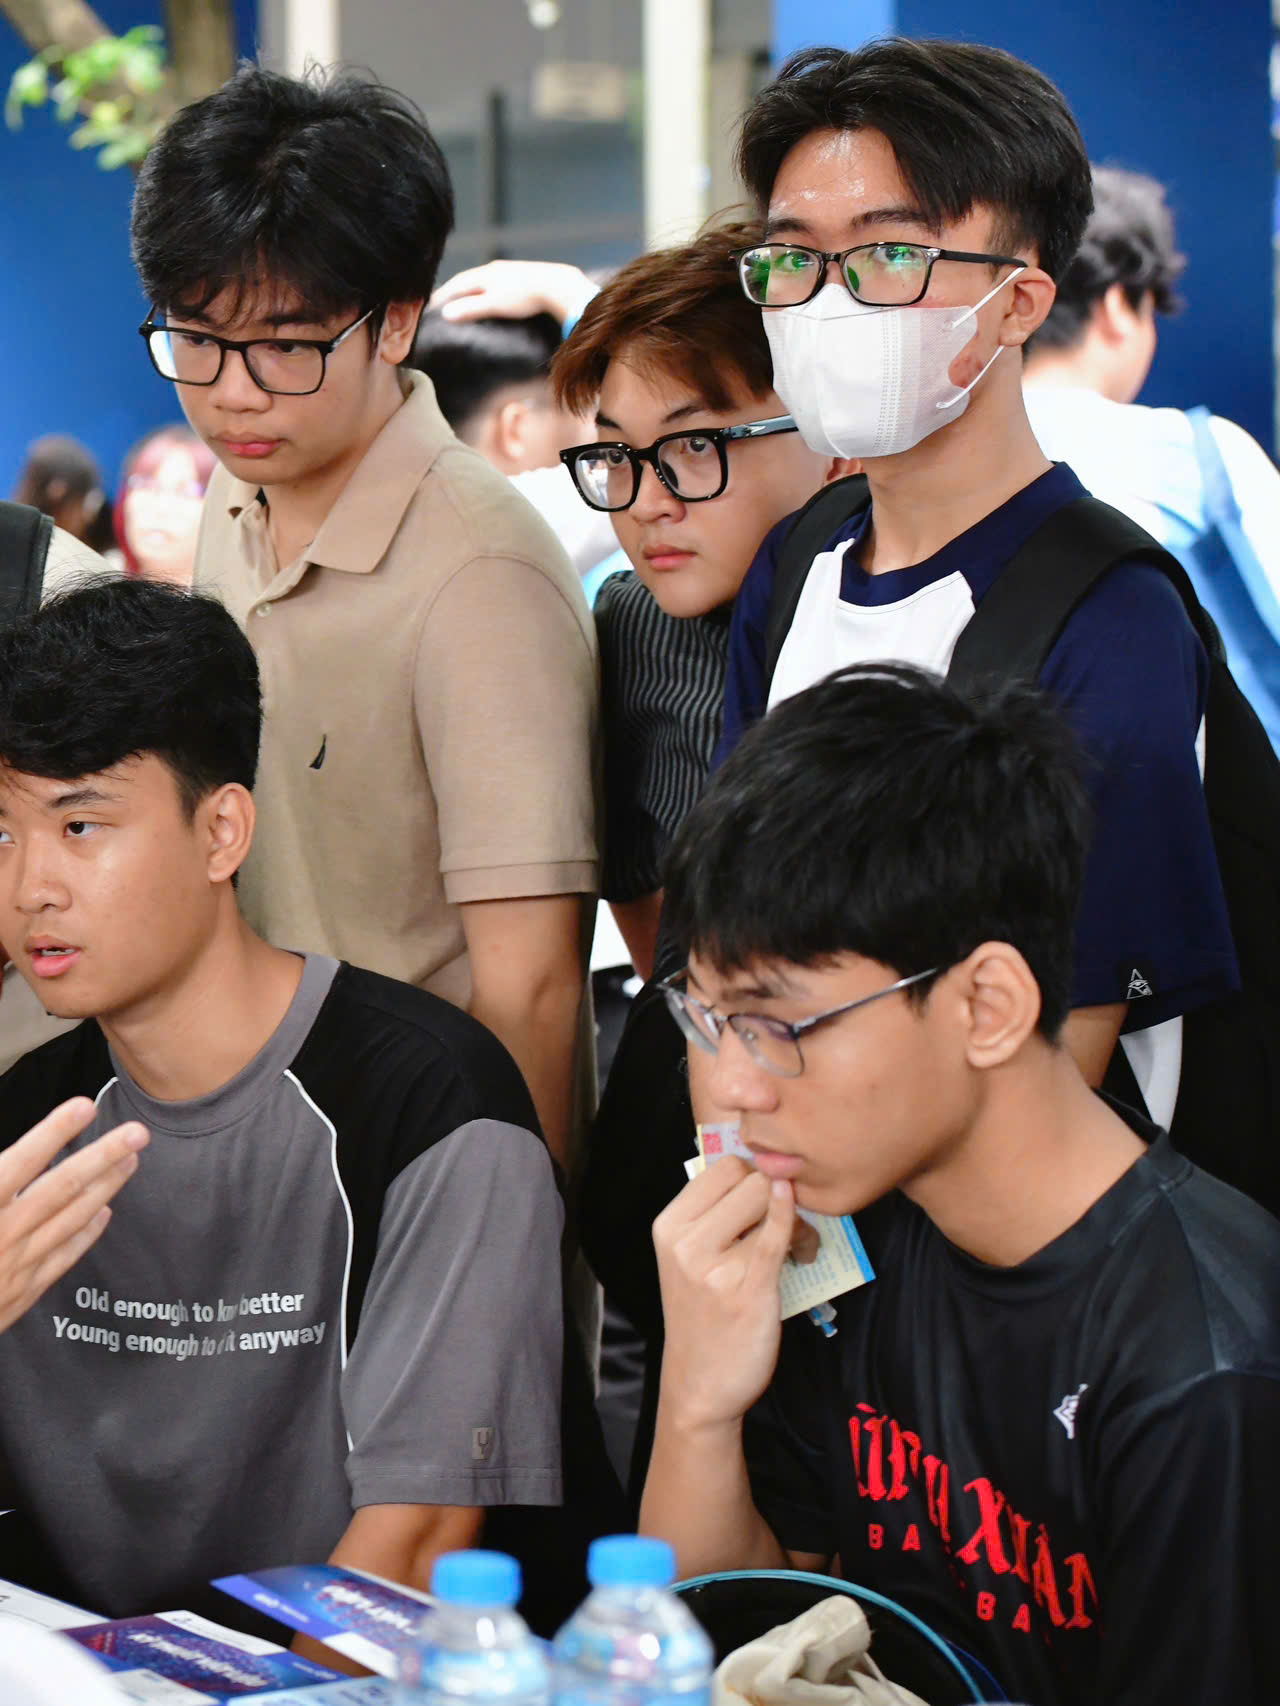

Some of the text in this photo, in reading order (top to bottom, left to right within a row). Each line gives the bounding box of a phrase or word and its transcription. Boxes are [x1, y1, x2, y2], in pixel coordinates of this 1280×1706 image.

[75, 1286, 109, 1313] Old
[114, 1299, 189, 1327] enough
[192, 1302, 215, 1323] to
[239, 1292, 305, 1316] better
[52, 1315, 120, 1353] Young
[125, 1333, 199, 1361] enough
[201, 1336, 216, 1356] to
[239, 1320, 326, 1354] anyway
